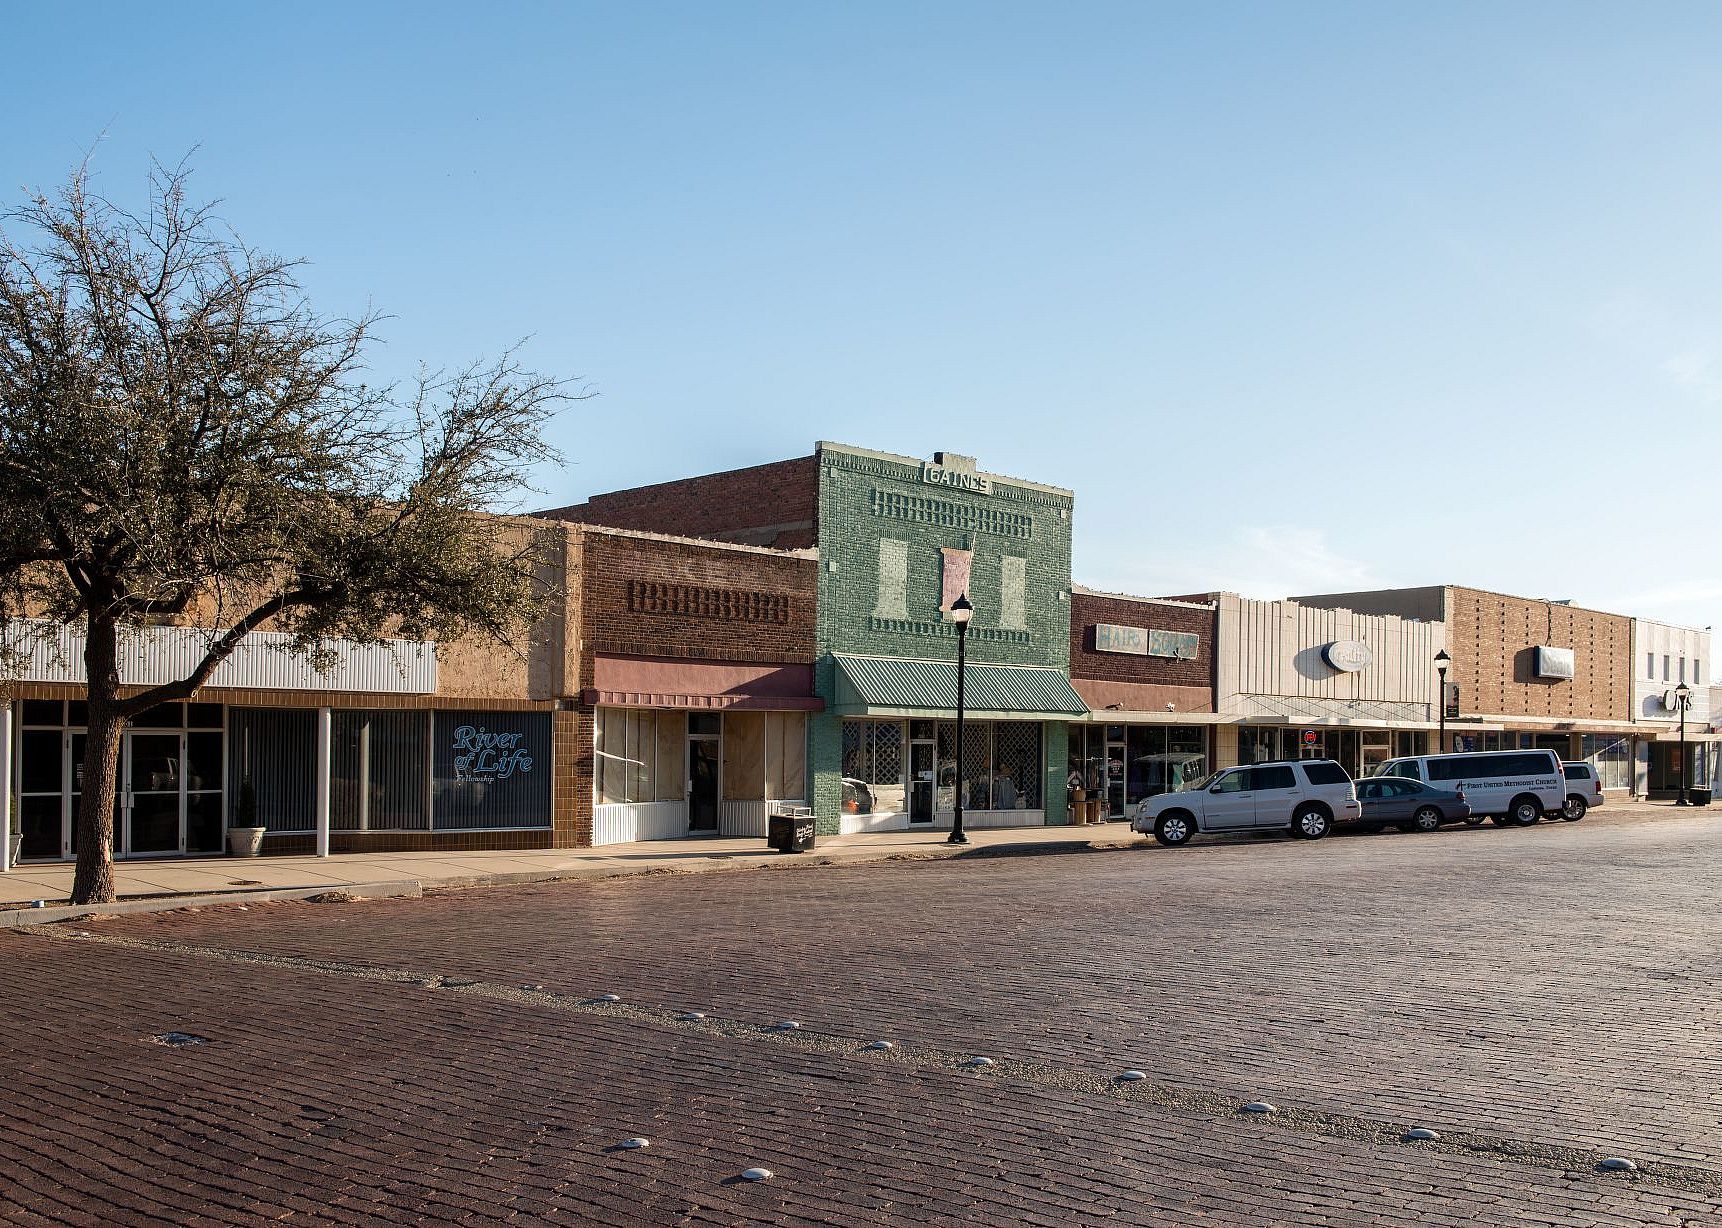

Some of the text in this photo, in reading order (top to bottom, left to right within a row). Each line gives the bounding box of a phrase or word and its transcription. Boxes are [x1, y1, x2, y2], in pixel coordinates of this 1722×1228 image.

[930, 467, 988, 492] GAINES
[453, 725, 523, 753] River
[454, 749, 533, 779] of Life
[456, 774, 495, 784] Fellowship
